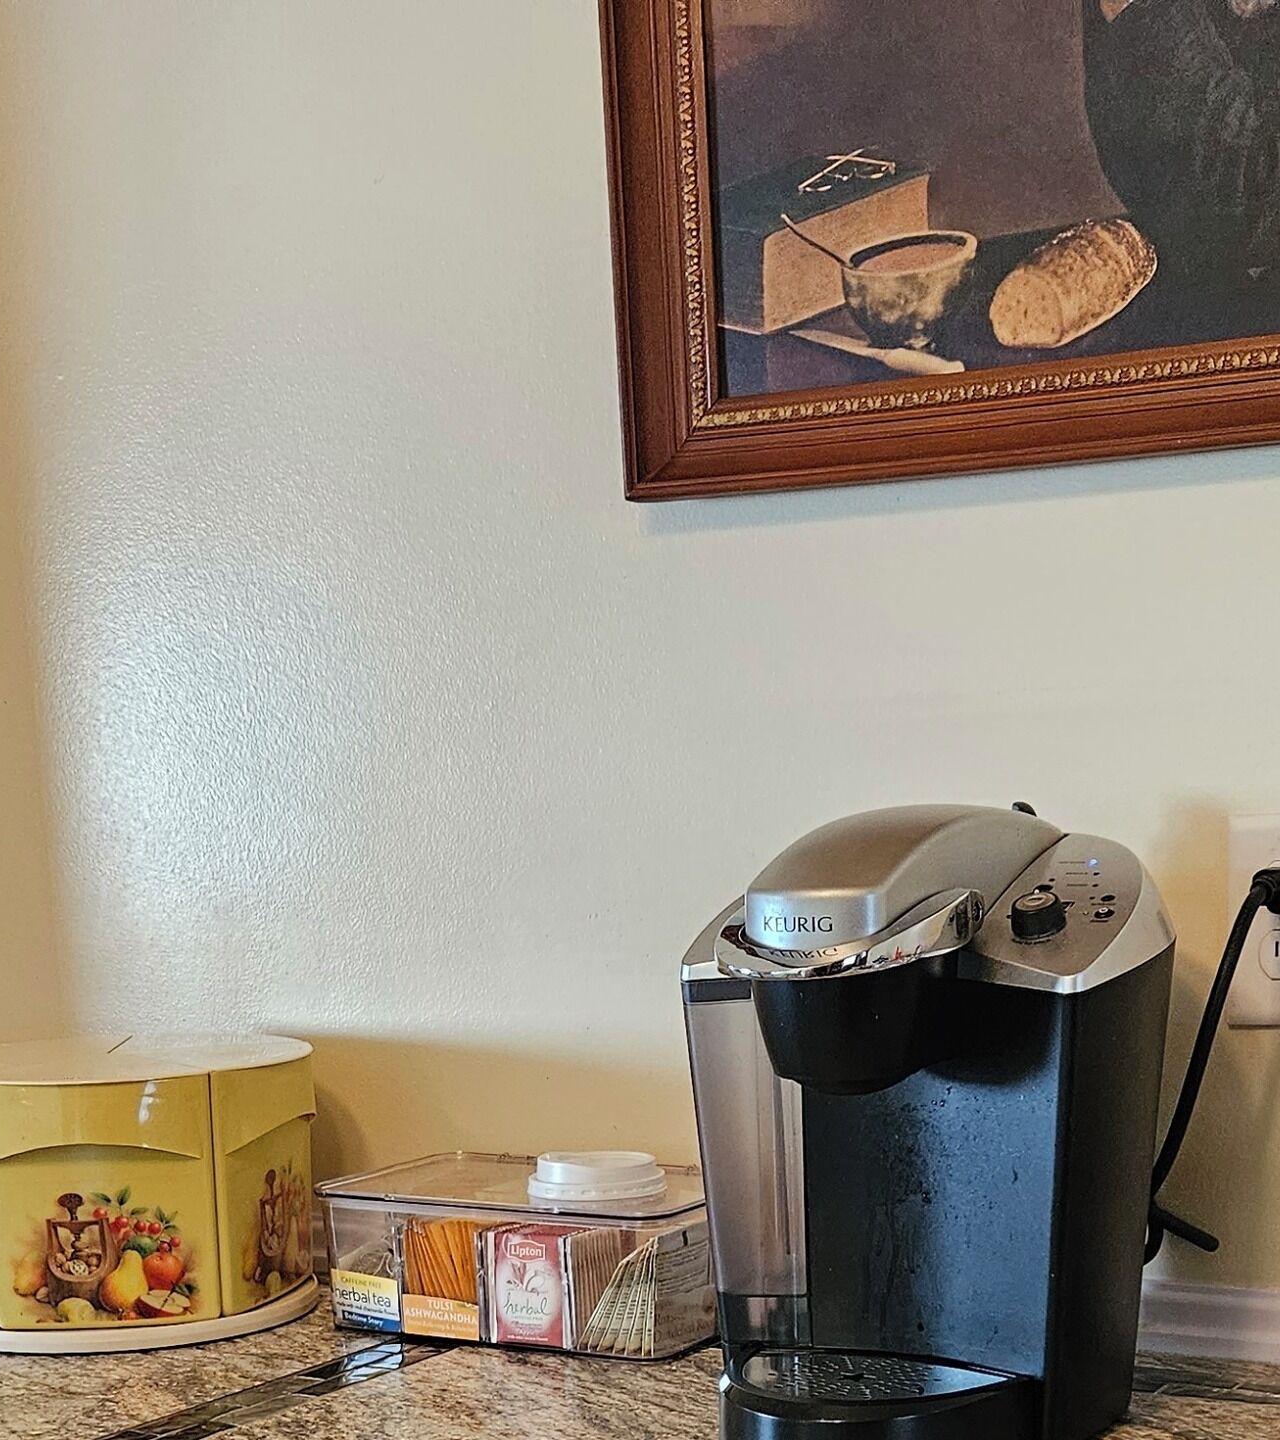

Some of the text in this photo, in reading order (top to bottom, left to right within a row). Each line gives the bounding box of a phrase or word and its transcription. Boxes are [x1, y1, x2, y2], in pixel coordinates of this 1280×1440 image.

[763, 916, 833, 933] KEURIG
[511, 1244, 543, 1257] Lipton
[373, 1293, 392, 1308] tea
[427, 1300, 453, 1310] TULSI
[504, 1292, 552, 1315] herbal
[405, 1308, 478, 1324] ASHWAGANDHA
